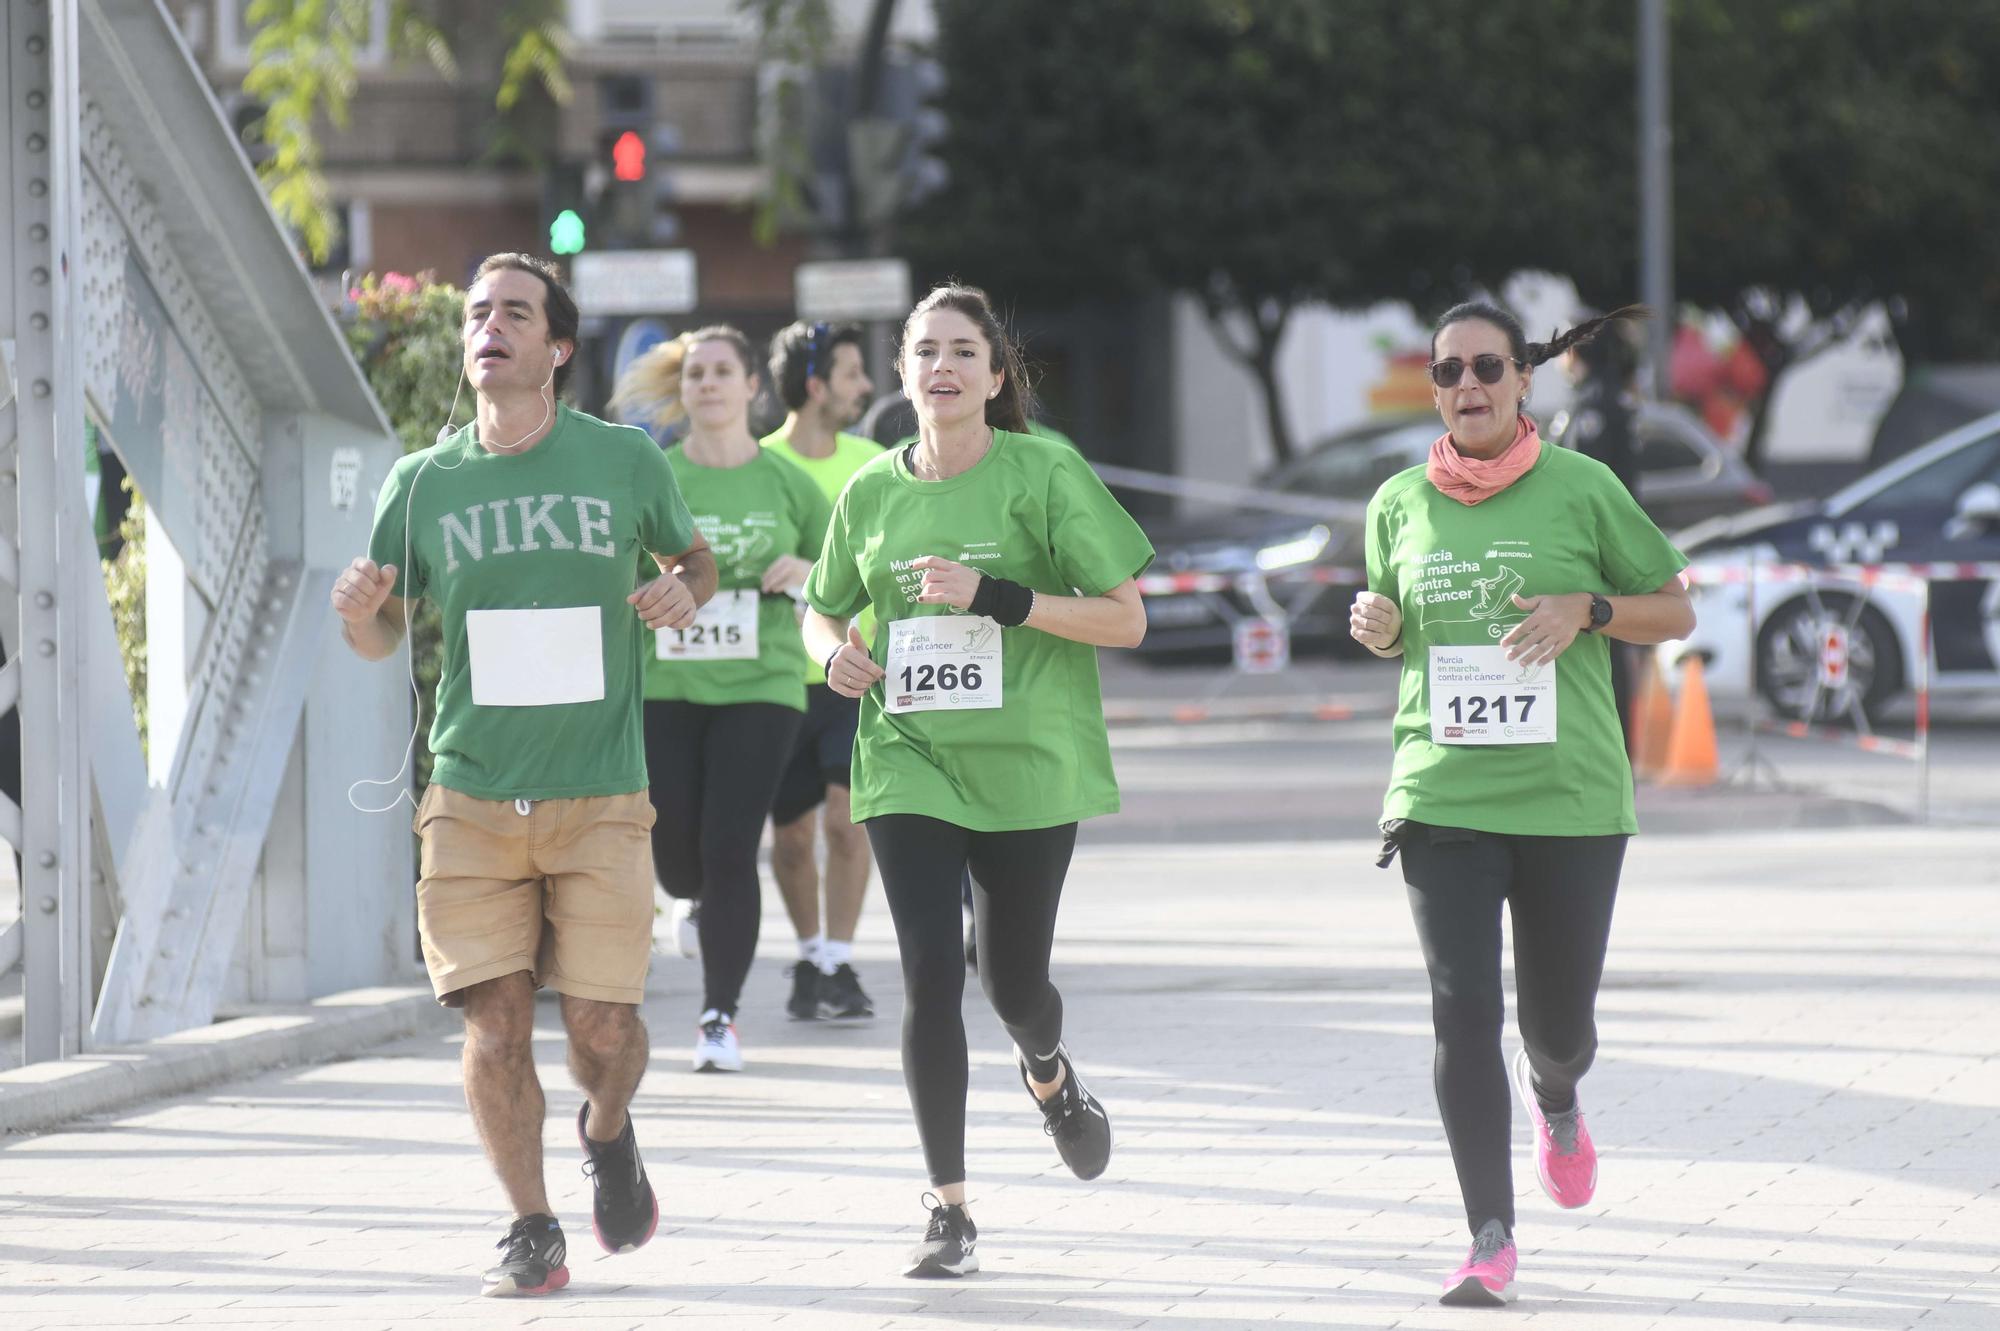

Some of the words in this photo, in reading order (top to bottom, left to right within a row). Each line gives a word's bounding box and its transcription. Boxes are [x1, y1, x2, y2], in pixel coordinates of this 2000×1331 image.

[437, 494, 616, 574] NIKE
[1498, 551, 1533, 559] IBERDROLA
[1427, 561, 1480, 577] marcha
[895, 574, 911, 584] en
[1413, 578, 1452, 593] contra
[901, 583, 924, 595] con
[1427, 588, 1474, 604] cáncer
[672, 625, 741, 645] 1215
[895, 644, 915, 654] conra
[916, 643, 924, 651] el
[1437, 656, 1464, 664] Murcia
[1448, 664, 1480, 672] marcha
[900, 663, 983, 692] 1266
[1438, 673, 1462, 681] contra
[1464, 673, 1473, 681] el
[1474, 672, 1505, 681] cáncer
[1448, 695, 1537, 724] 1217
